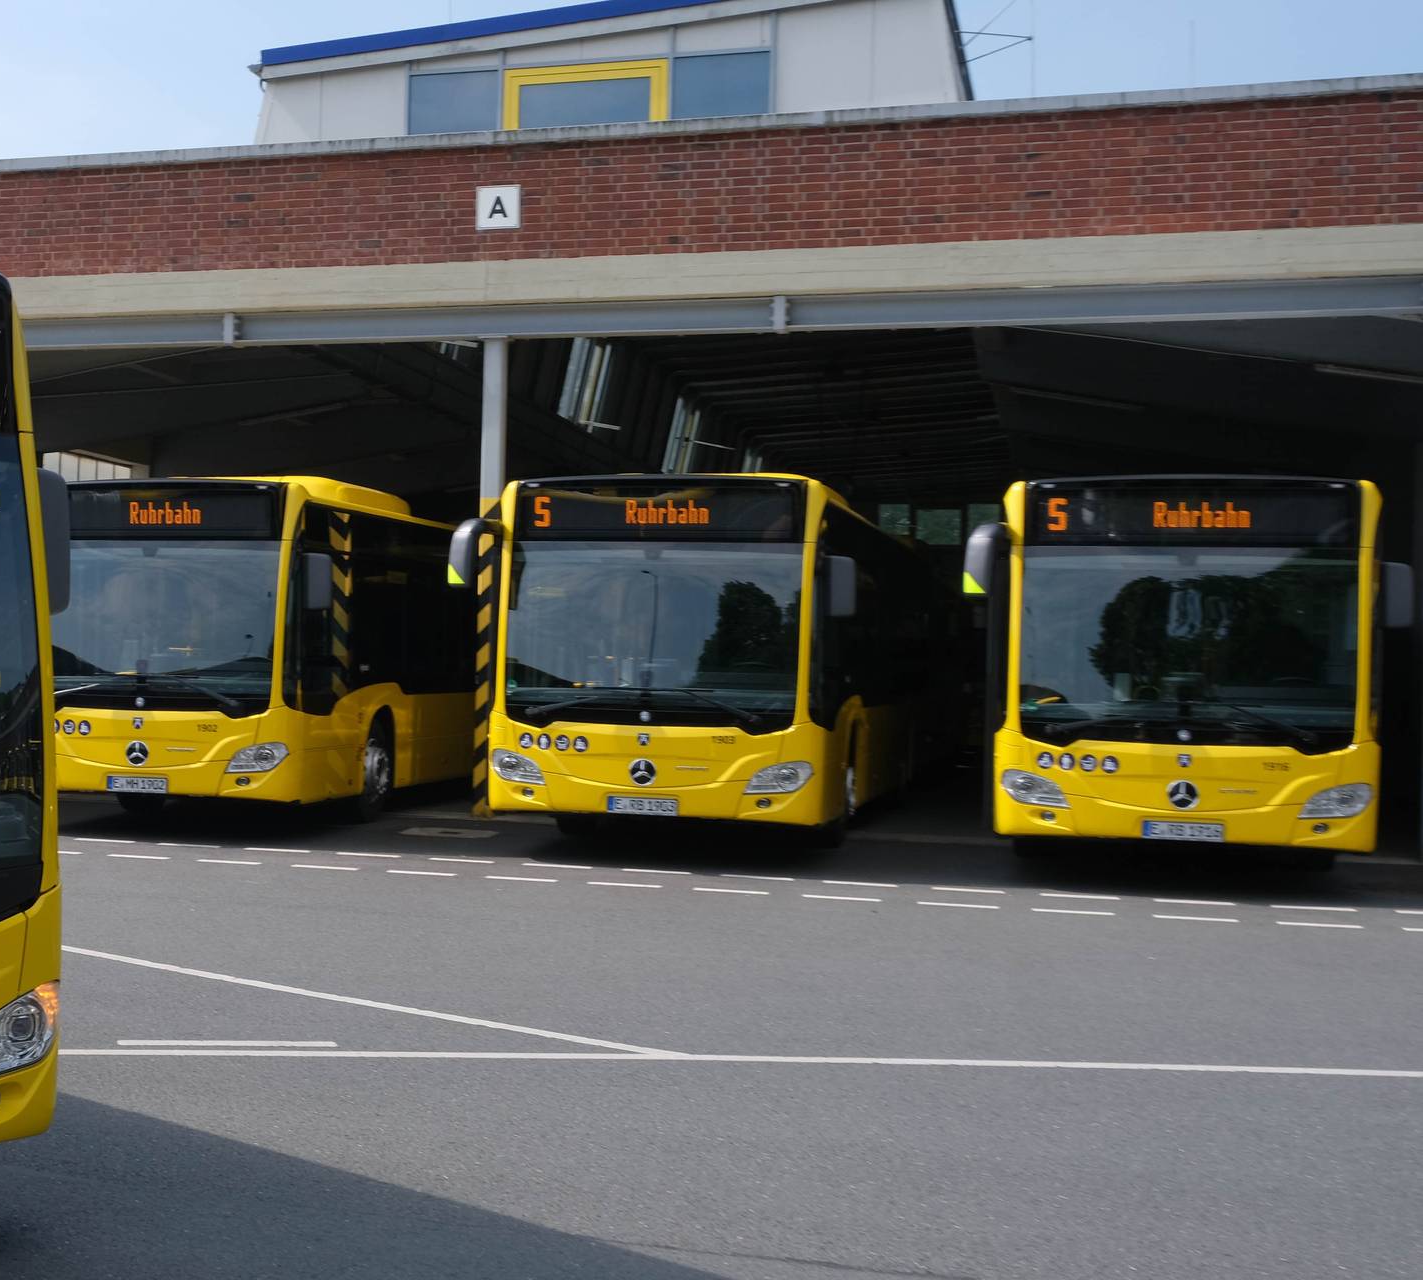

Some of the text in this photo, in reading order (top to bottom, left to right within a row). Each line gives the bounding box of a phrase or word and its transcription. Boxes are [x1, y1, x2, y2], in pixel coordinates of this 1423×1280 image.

[488, 195, 508, 219] A
[129, 501, 202, 525] Ruhrbahn
[626, 500, 710, 525] Ruhrbahn
[1153, 501, 1251, 528] Ruhrbahn
[113, 778, 165, 790] E MH 1902
[614, 799, 622, 810] E
